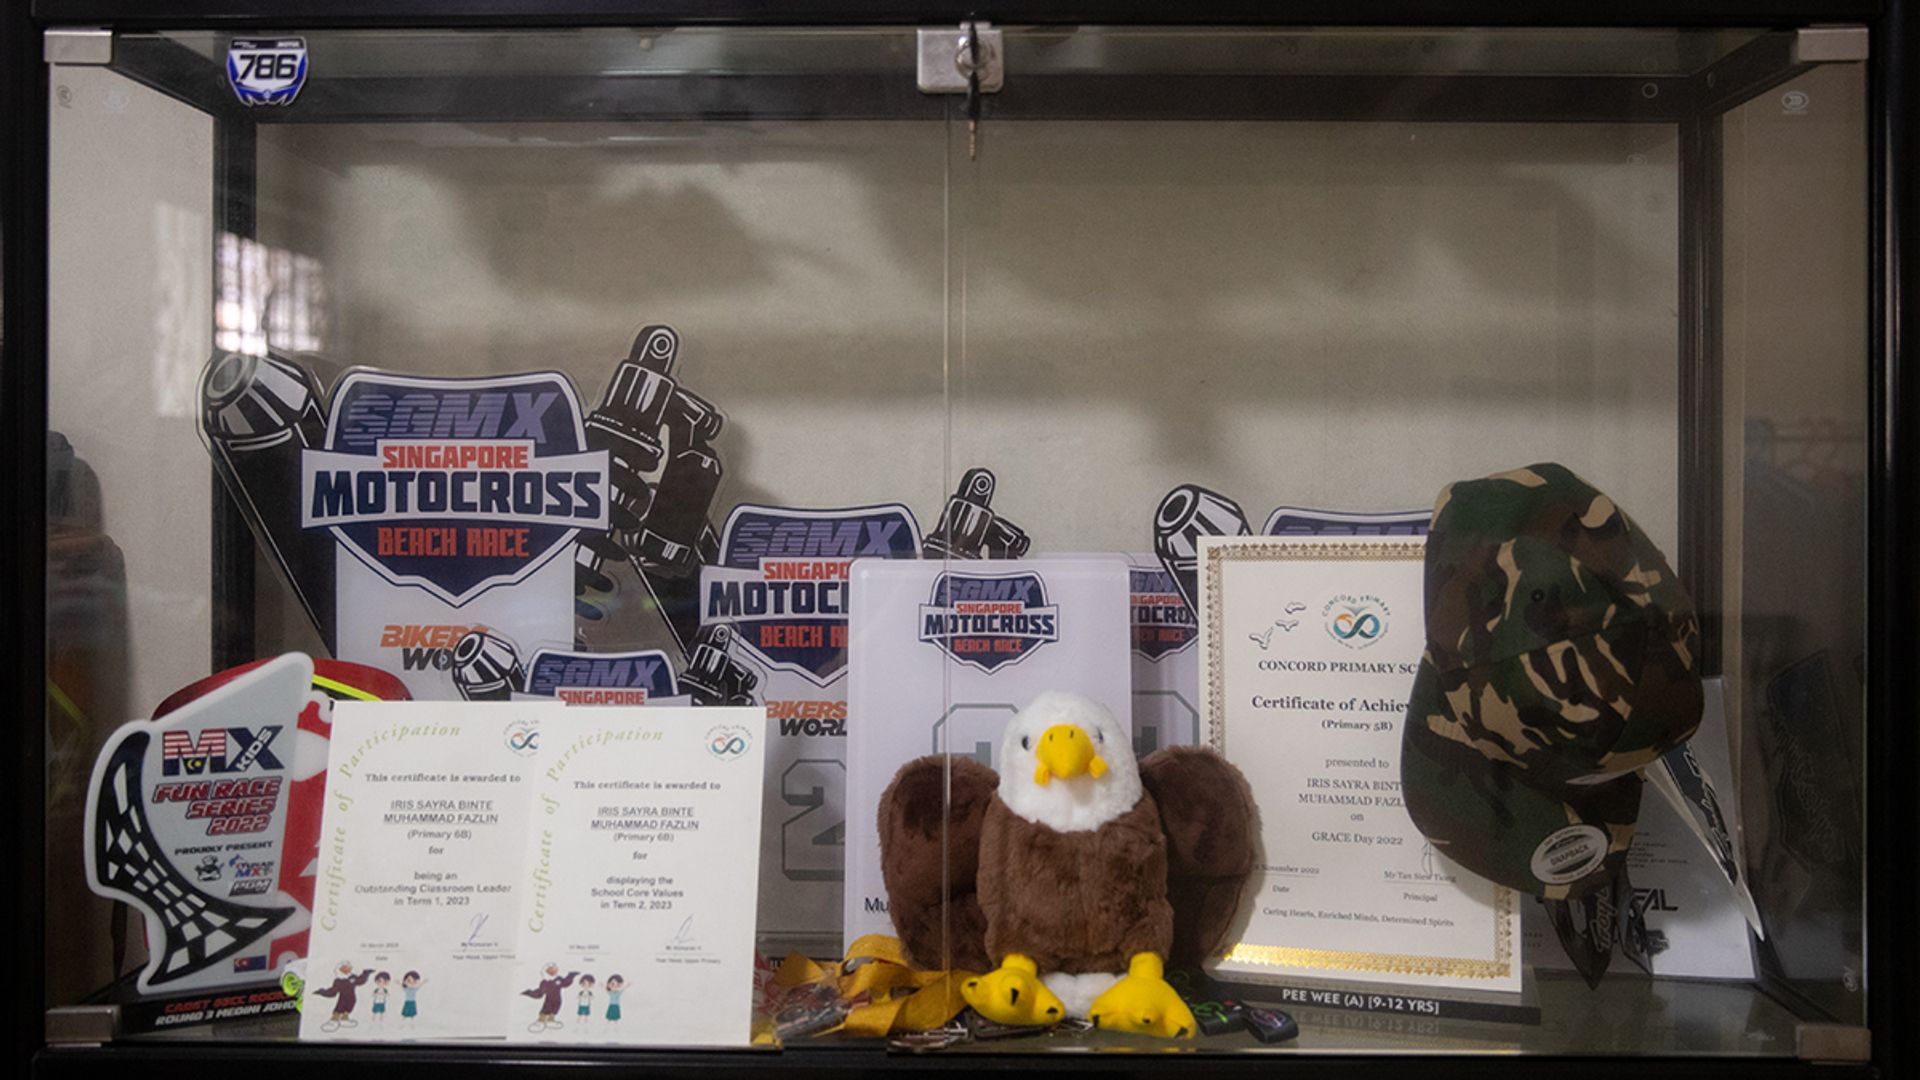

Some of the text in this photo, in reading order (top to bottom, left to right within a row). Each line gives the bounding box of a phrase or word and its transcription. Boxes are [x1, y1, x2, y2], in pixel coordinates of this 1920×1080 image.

[239, 54, 298, 80] 786
[343, 392, 560, 445] SGMX
[383, 446, 528, 469] SINGAPORE
[311, 471, 601, 520] MOTOCROSS
[378, 527, 530, 556] BEACH RACE
[732, 520, 902, 562] SGMX
[938, 580, 1036, 603] SGMX
[955, 603, 1022, 614] SINGAPORE
[925, 614, 1055, 635] MOTOCROSS
[760, 625, 823, 648] BEACH
[1258, 659, 1327, 672] CONCORD
[1330, 661, 1396, 674] PRIMARY
[535, 659, 662, 691] SGMX
[558, 690, 645, 706] SINGAPORE
[1252, 694, 1335, 710] Certificate
[1338, 698, 1356, 711] of
[766, 700, 847, 719] BIKERS
[1321, 719, 1394, 732] (Primary 5B)
[163, 726, 285, 776] MX
[236, 728, 272, 770] KIDS
[1325, 758, 1390, 768] presented to
[365, 773, 521, 783] This certificate is awarded to
[573, 780, 721, 790] This certificate is awarded to
[1307, 778, 1331, 788] IRIS
[1332, 779, 1370, 790] SAYRA
[153, 777, 283, 804] FUN RACE
[390, 800, 494, 810] IRIS SAYRA BINTE
[1298, 793, 1373, 806] MUHAMMAD
[185, 798, 277, 819] SERIES
[598, 807, 694, 817] IRIS SAYRA BINTE
[383, 814, 499, 824] MUHAMMAD FAZLIN
[1350, 813, 1365, 821] on
[206, 815, 271, 836] 2022
[320, 722, 462, 932] Certificate of Participation
[528, 727, 663, 933] Certificate of Participation
[591, 820, 699, 830] MUHAMMAD FAZLIN
[407, 830, 472, 841] (Primary 6B)
[613, 832, 655, 843] (Primary
[1312, 832, 1404, 846] GRACE Day 2022
[175, 841, 274, 855] PROUDLY PRESENT
[428, 846, 444, 855] for
[633, 851, 648, 860] for
[414, 872, 442, 882] being
[606, 875, 674, 886] displaying the
[355, 884, 511, 895] Outstanding Classroom Leader
[591, 888, 684, 898] School Core Values
[1272, 885, 1290, 893] Date
[393, 898, 405, 906] in
[407, 898, 432, 906] Term
[446, 897, 470, 906] 2023
[1403, 892, 1438, 903] Principal
[600, 901, 610, 910] in
[613, 901, 636, 910] Term
[650, 901, 673, 910] 2023
[1262, 907, 1287, 918] Caring
[1318, 910, 1352, 921] Enriched
[1382, 915, 1427, 926] Determined
[1282, 988, 1440, 1015] PEE WEE (A) [9-12 YRS]
[155, 1012, 203, 1026] ROUND
[216, 1004, 262, 1018] MEDINI
